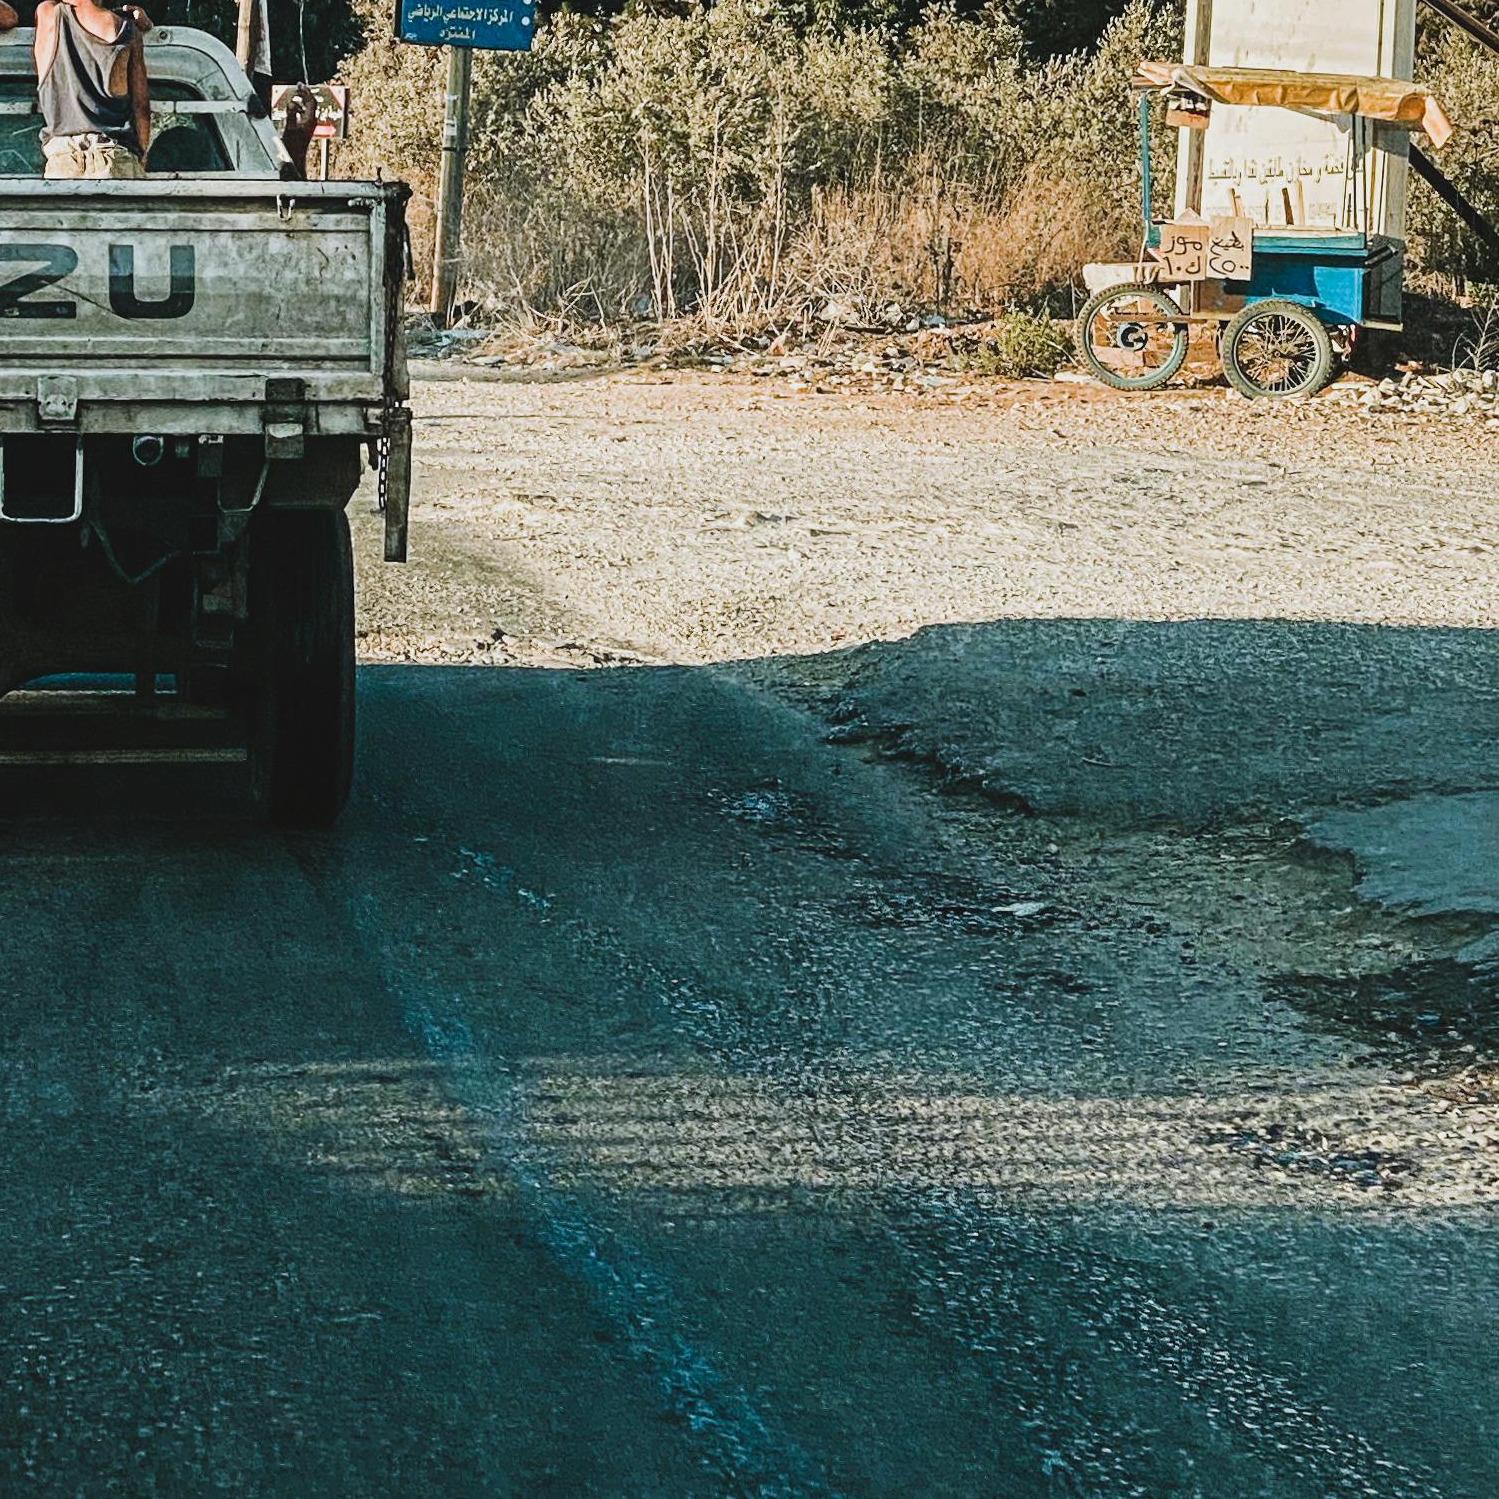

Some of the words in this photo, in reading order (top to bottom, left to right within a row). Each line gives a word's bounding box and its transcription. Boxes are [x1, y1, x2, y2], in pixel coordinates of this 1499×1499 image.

[407, 3, 443, 23] الرياضي
[442, 6, 488, 24] الاجتماعي
[487, 7, 514, 26] المركز
[1164, 236, 1203, 256] موز
